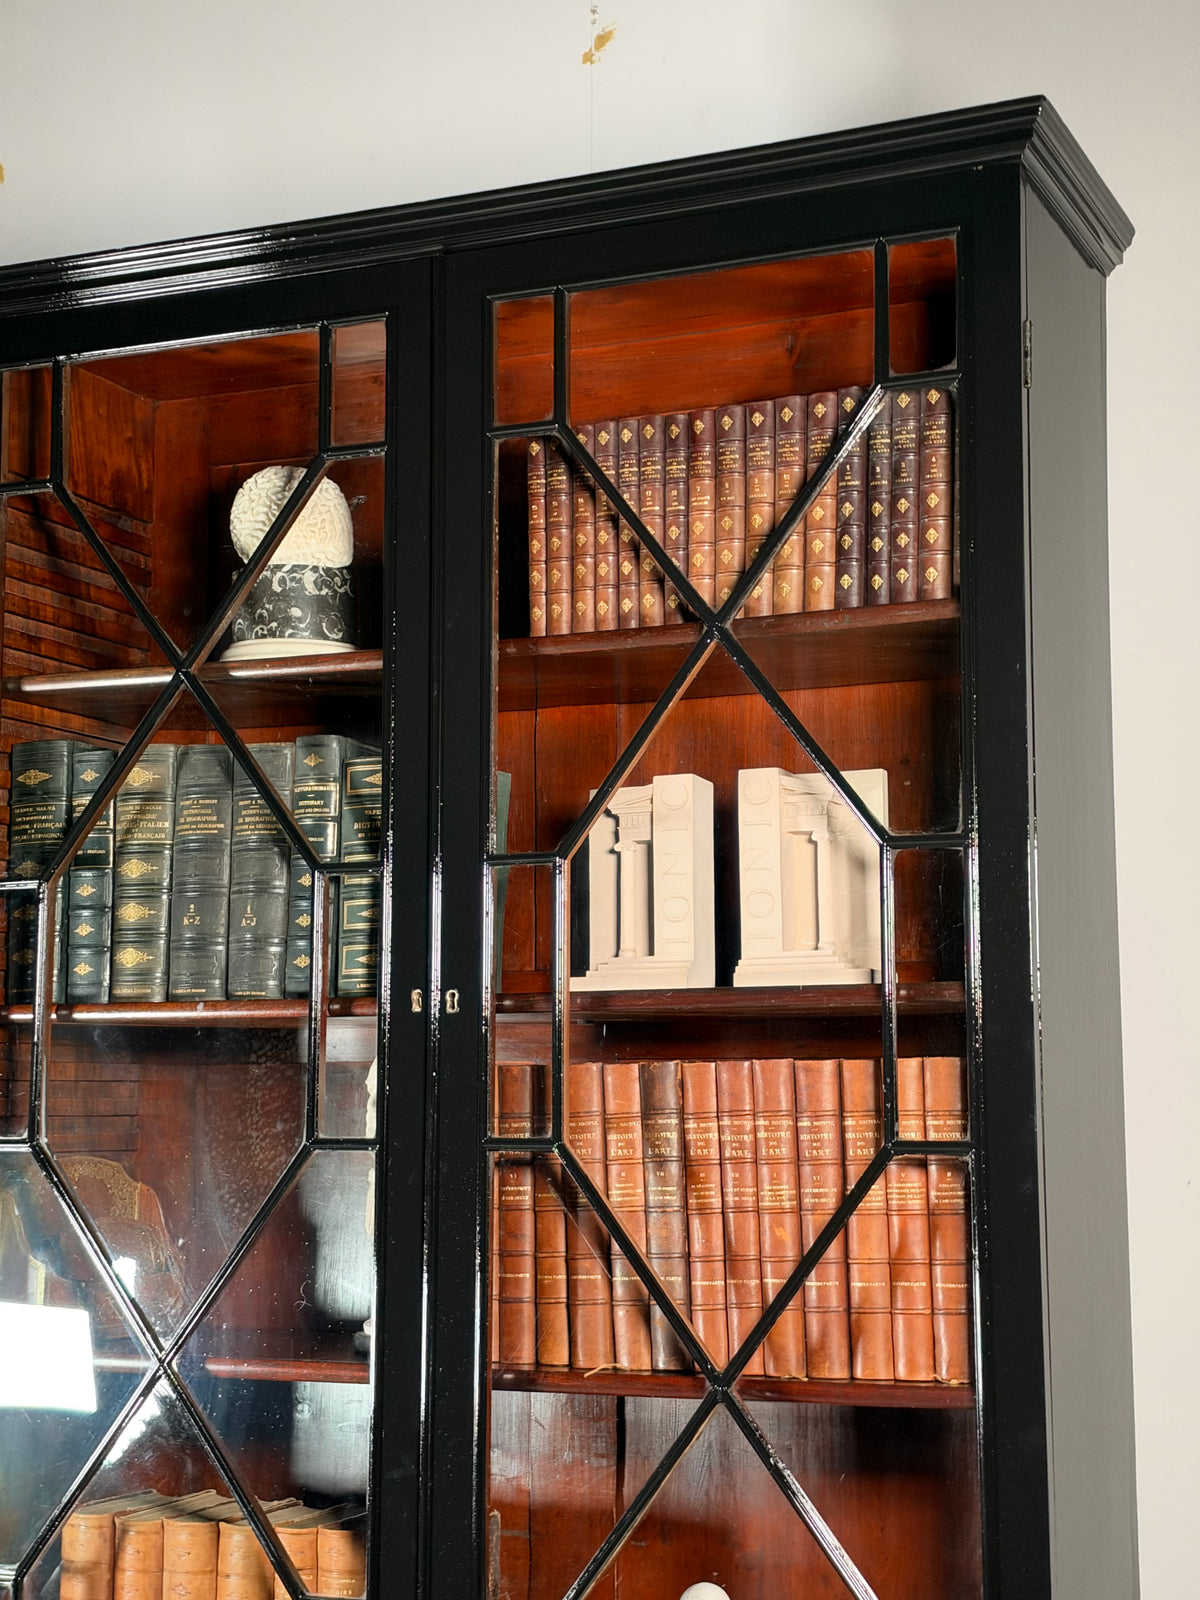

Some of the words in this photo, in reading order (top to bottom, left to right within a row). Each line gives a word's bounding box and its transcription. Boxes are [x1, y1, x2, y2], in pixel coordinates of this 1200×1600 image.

[353, 821, 381, 830] DICTIO
[660, 783, 690, 944] IONIC
[743, 777, 776, 941] IONIC
